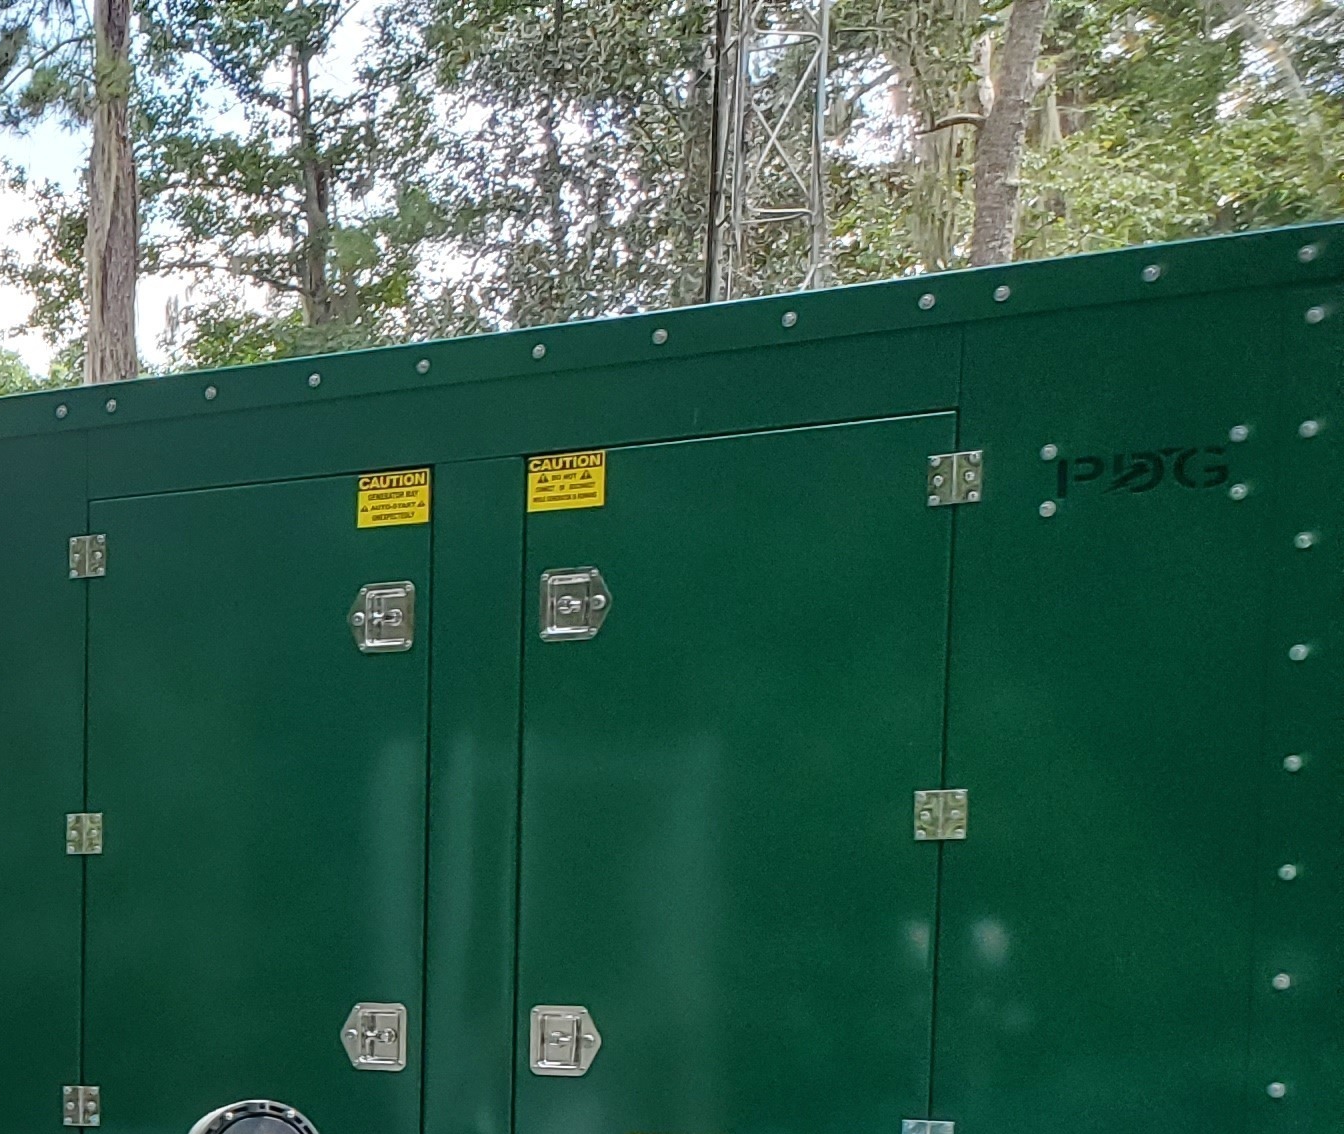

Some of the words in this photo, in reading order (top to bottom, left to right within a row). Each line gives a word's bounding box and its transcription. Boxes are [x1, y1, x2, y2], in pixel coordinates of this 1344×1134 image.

[528, 453, 601, 472] CAUTION
[359, 472, 425, 490] CAUTION
[370, 501, 417, 512] AUTO-START
